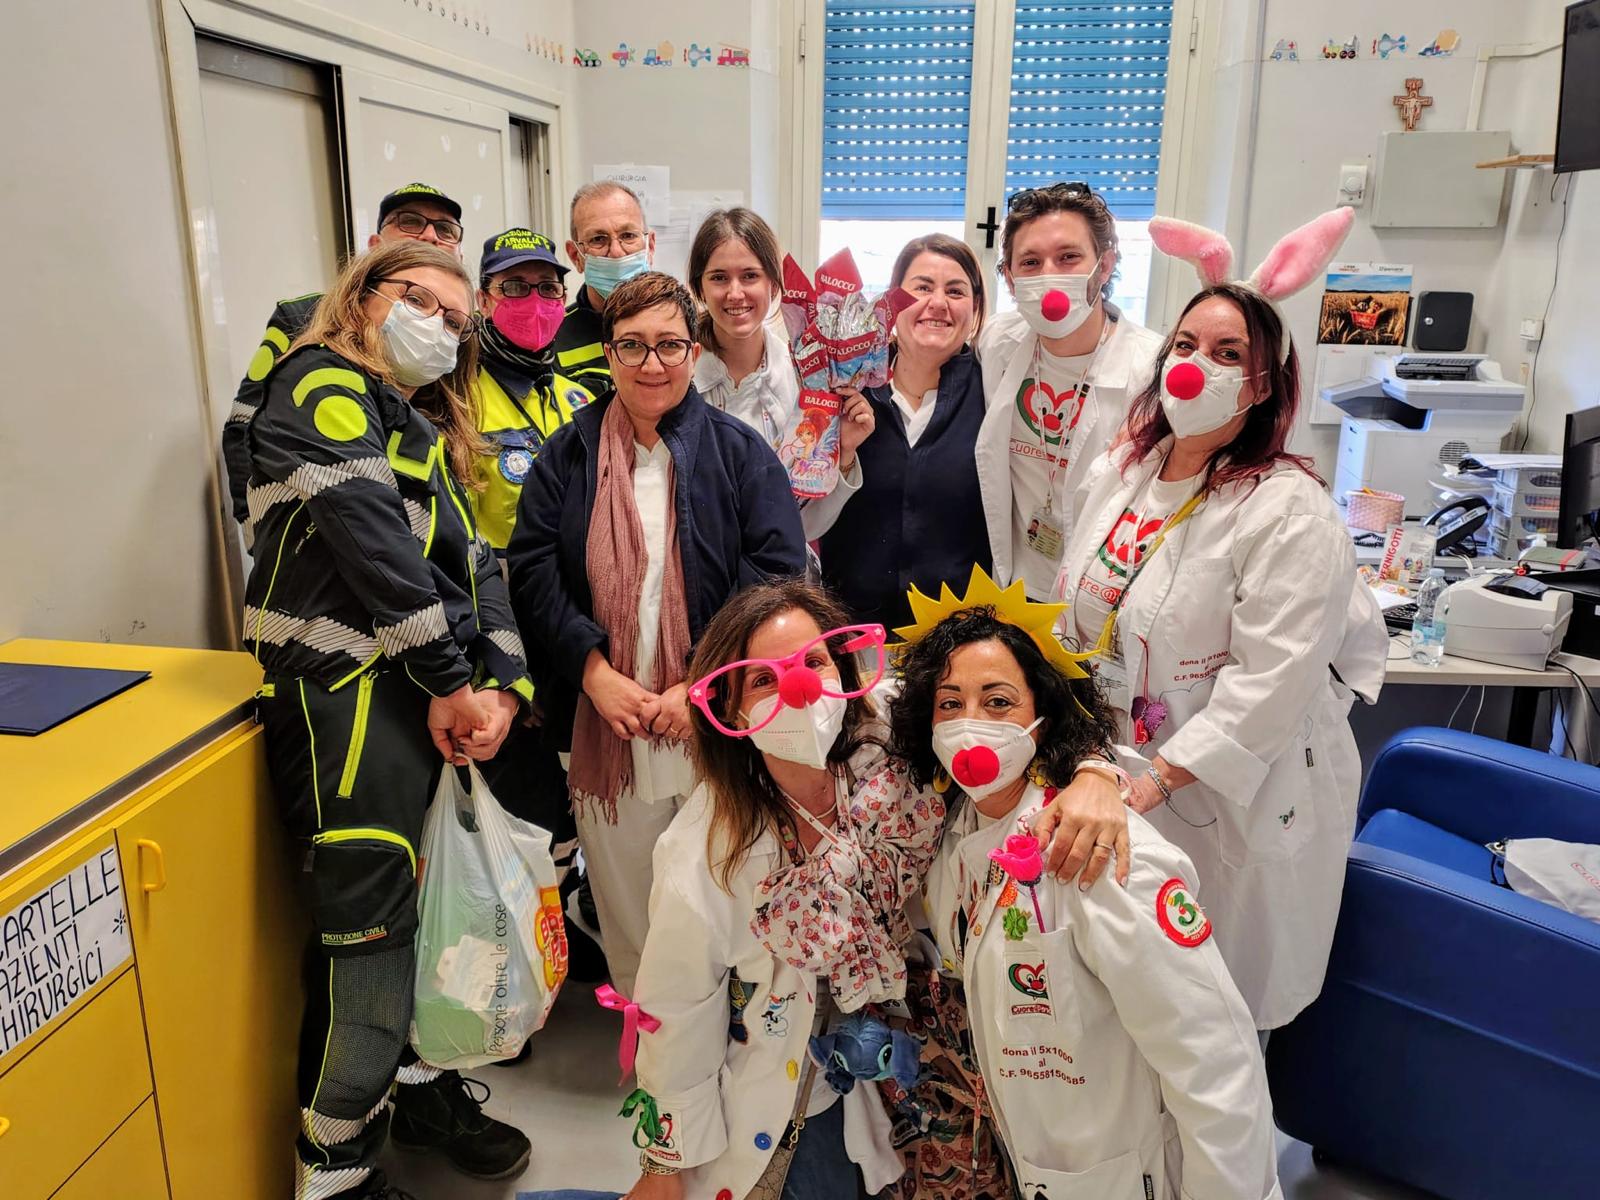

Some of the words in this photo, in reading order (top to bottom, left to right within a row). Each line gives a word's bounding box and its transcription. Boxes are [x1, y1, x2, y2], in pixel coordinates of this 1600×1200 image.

[504, 237, 542, 248] ARVALIA
[804, 395, 839, 409] BALOCCO
[1379, 527, 1404, 580] PERNIGOTTI
[495, 904, 507, 937] cose
[322, 931, 364, 942] PROTEZIONE
[364, 924, 386, 936] CIVILE
[490, 943, 508, 957] le
[0, 919, 80, 1008] AZIENTI
[490, 962, 508, 999] oltre
[0, 940, 104, 1055] HIRURGICI
[489, 1003, 508, 1053] Persone
[1002, 1047, 1029, 1057] dona
[1030, 1046, 1037, 1056] il
[1039, 1045, 1073, 1064] 5x1000
[1038, 1058, 1047, 1068] al
[999, 1068, 1017, 1078] C.F.
